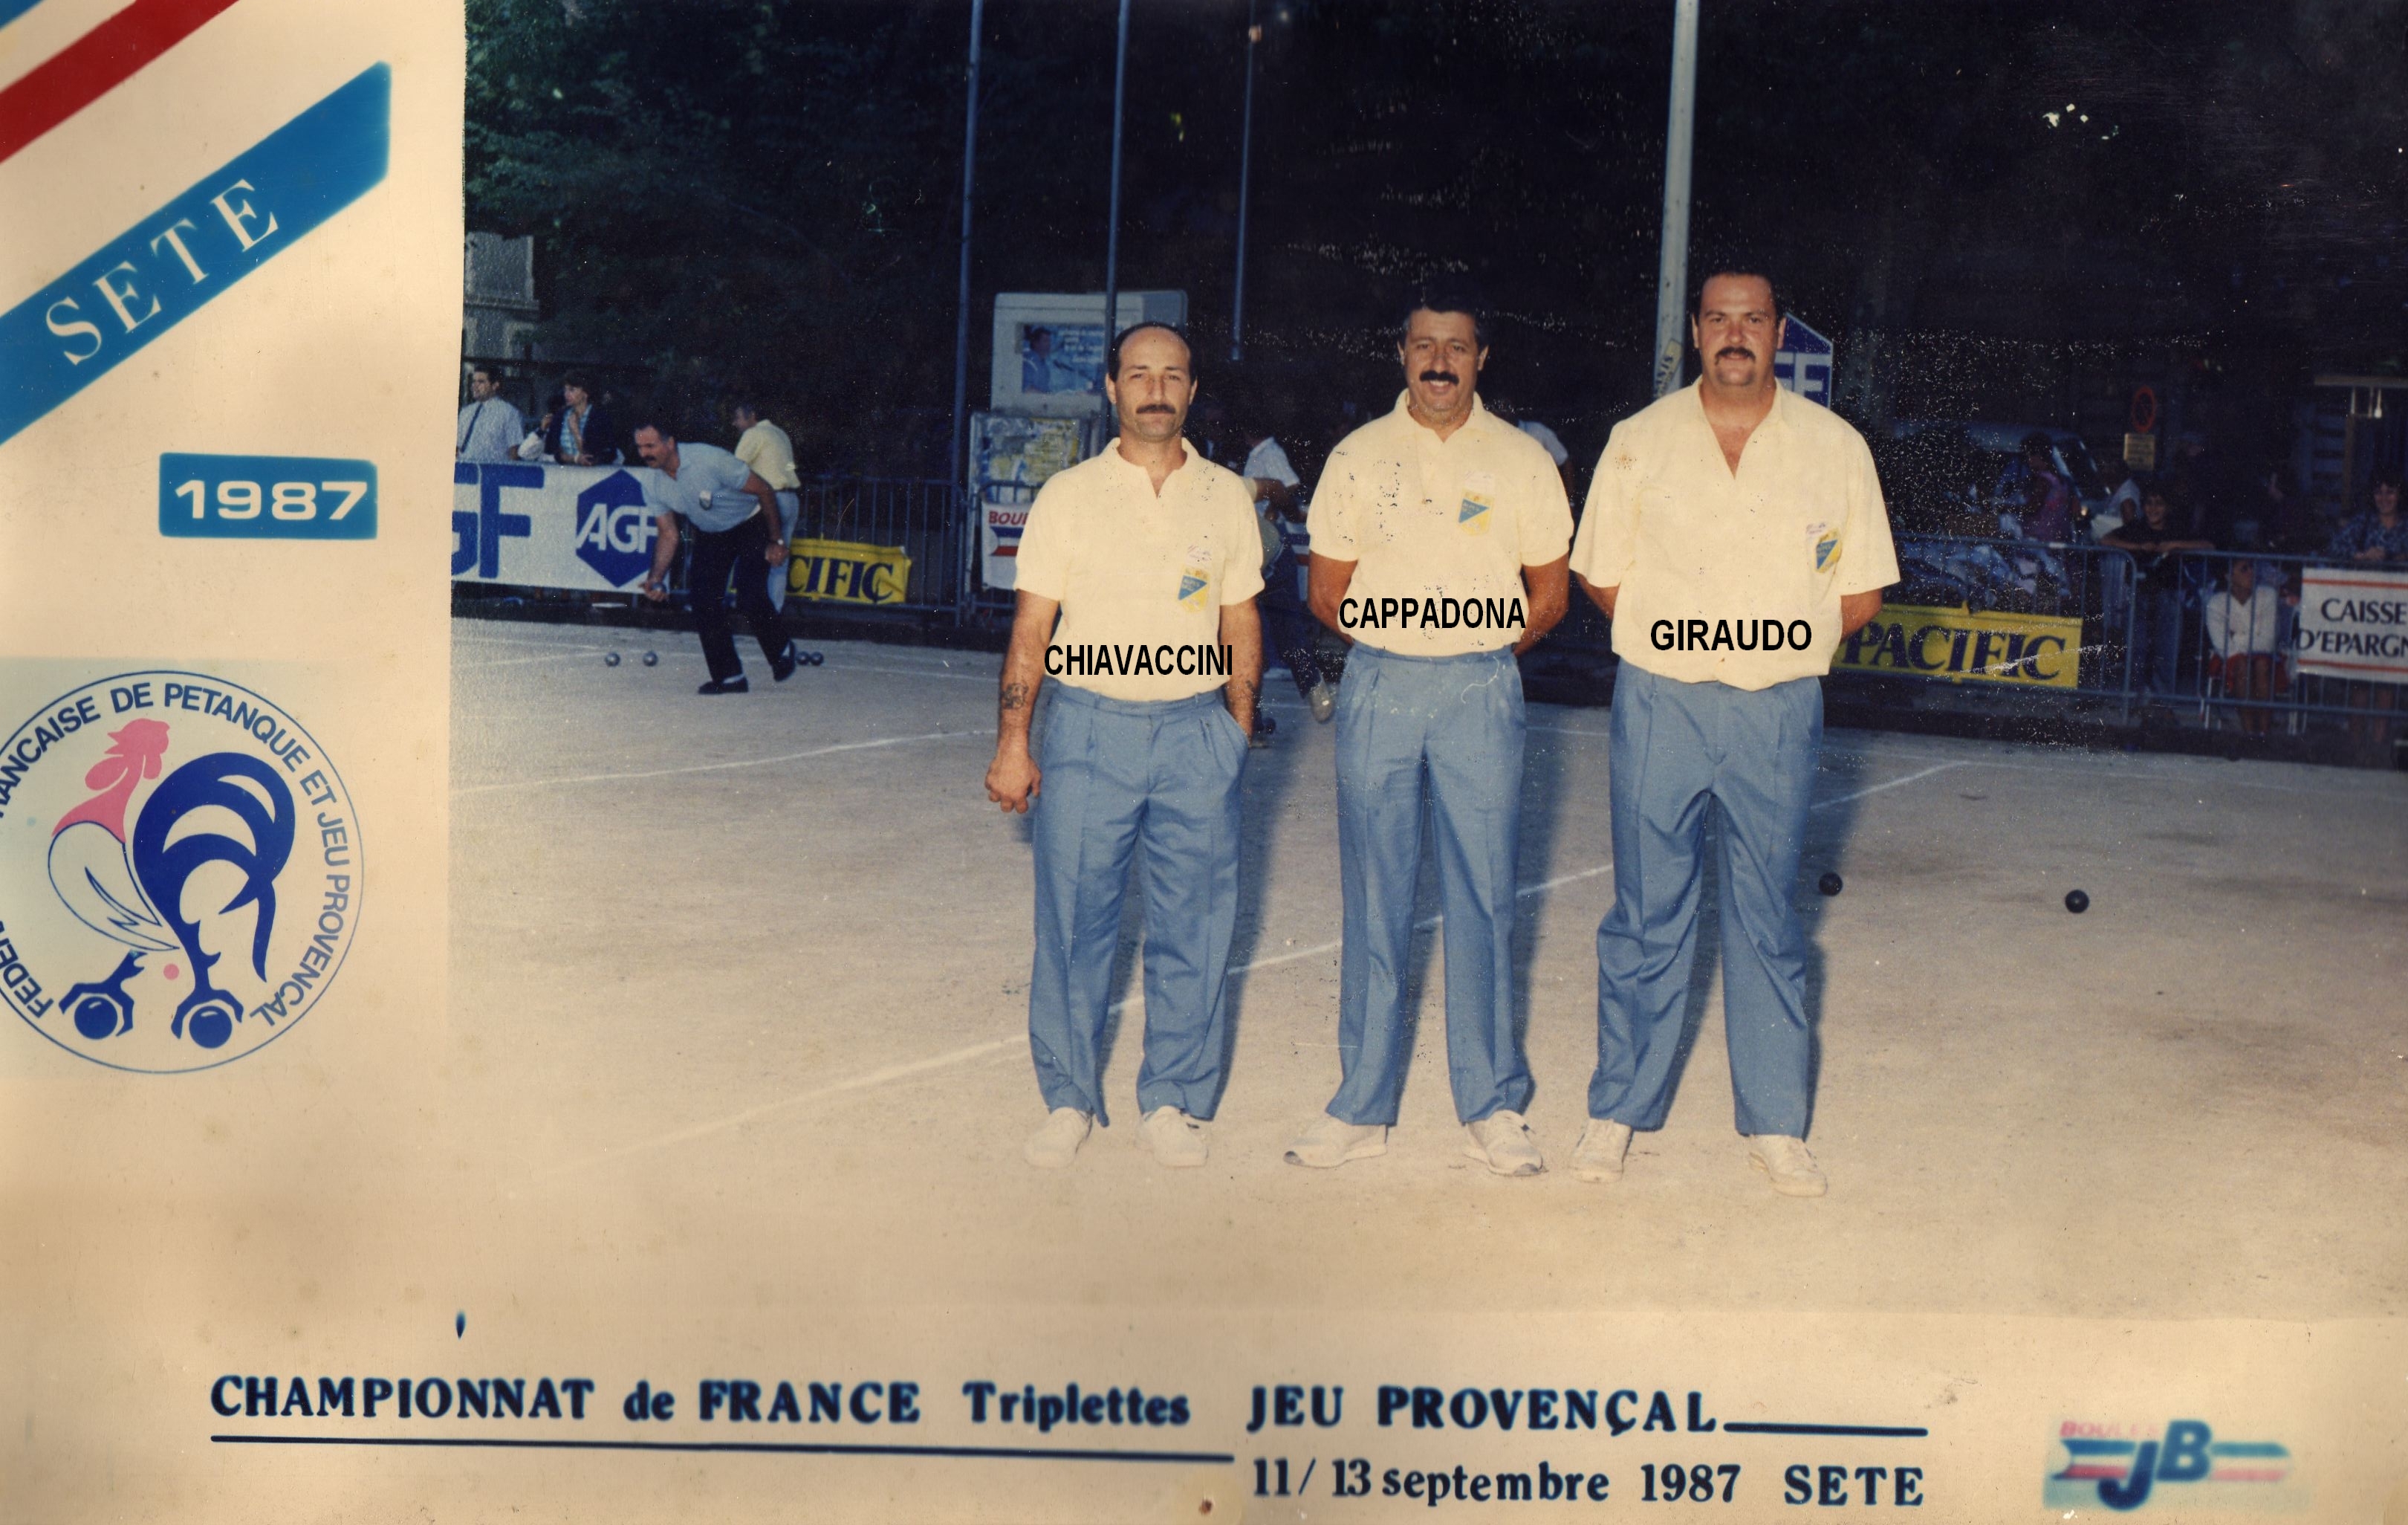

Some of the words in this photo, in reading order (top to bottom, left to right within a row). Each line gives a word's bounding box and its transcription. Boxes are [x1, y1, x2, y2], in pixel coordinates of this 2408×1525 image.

[575, 503, 659, 554] AGF
[2320, 598, 2407, 625] CAISSE
[1841, 621, 2066, 679] PACIFIC
[111, 682, 154, 713] DE
[164, 682, 311, 773] PETANQUE
[0, 696, 101, 818] ANCAISE
[299, 769, 337, 807] ET
[317, 812, 351, 867] JEU
[0, 920, 54, 1019] FEDE
[250, 874, 351, 1026] PROVENCAL
[2097, 1419, 2213, 1511] JB
